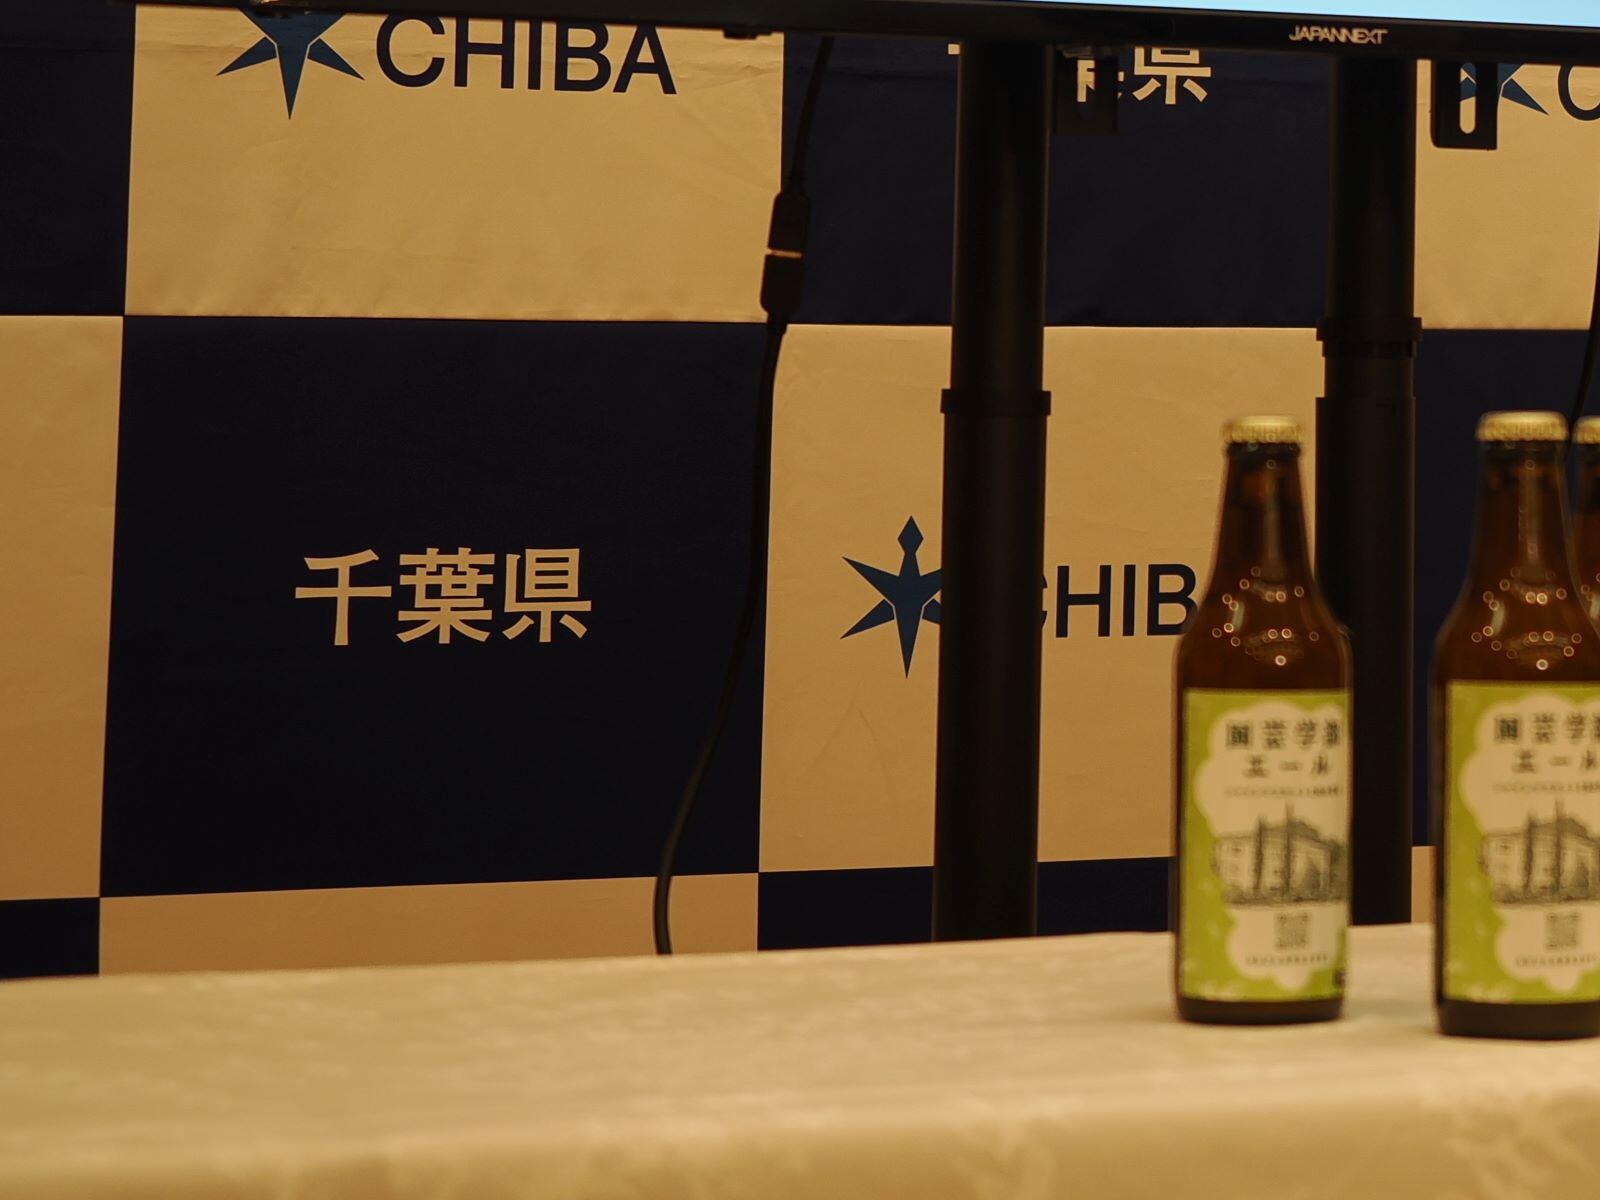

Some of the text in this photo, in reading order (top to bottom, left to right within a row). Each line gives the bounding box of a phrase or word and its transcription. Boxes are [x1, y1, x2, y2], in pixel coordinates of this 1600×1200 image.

[375, 12, 677, 95] CHIBA
[1289, 25, 1388, 44] JAPANNEXT
[295, 548, 592, 645] 千葉県
[1042, 563, 1198, 638] HIB
